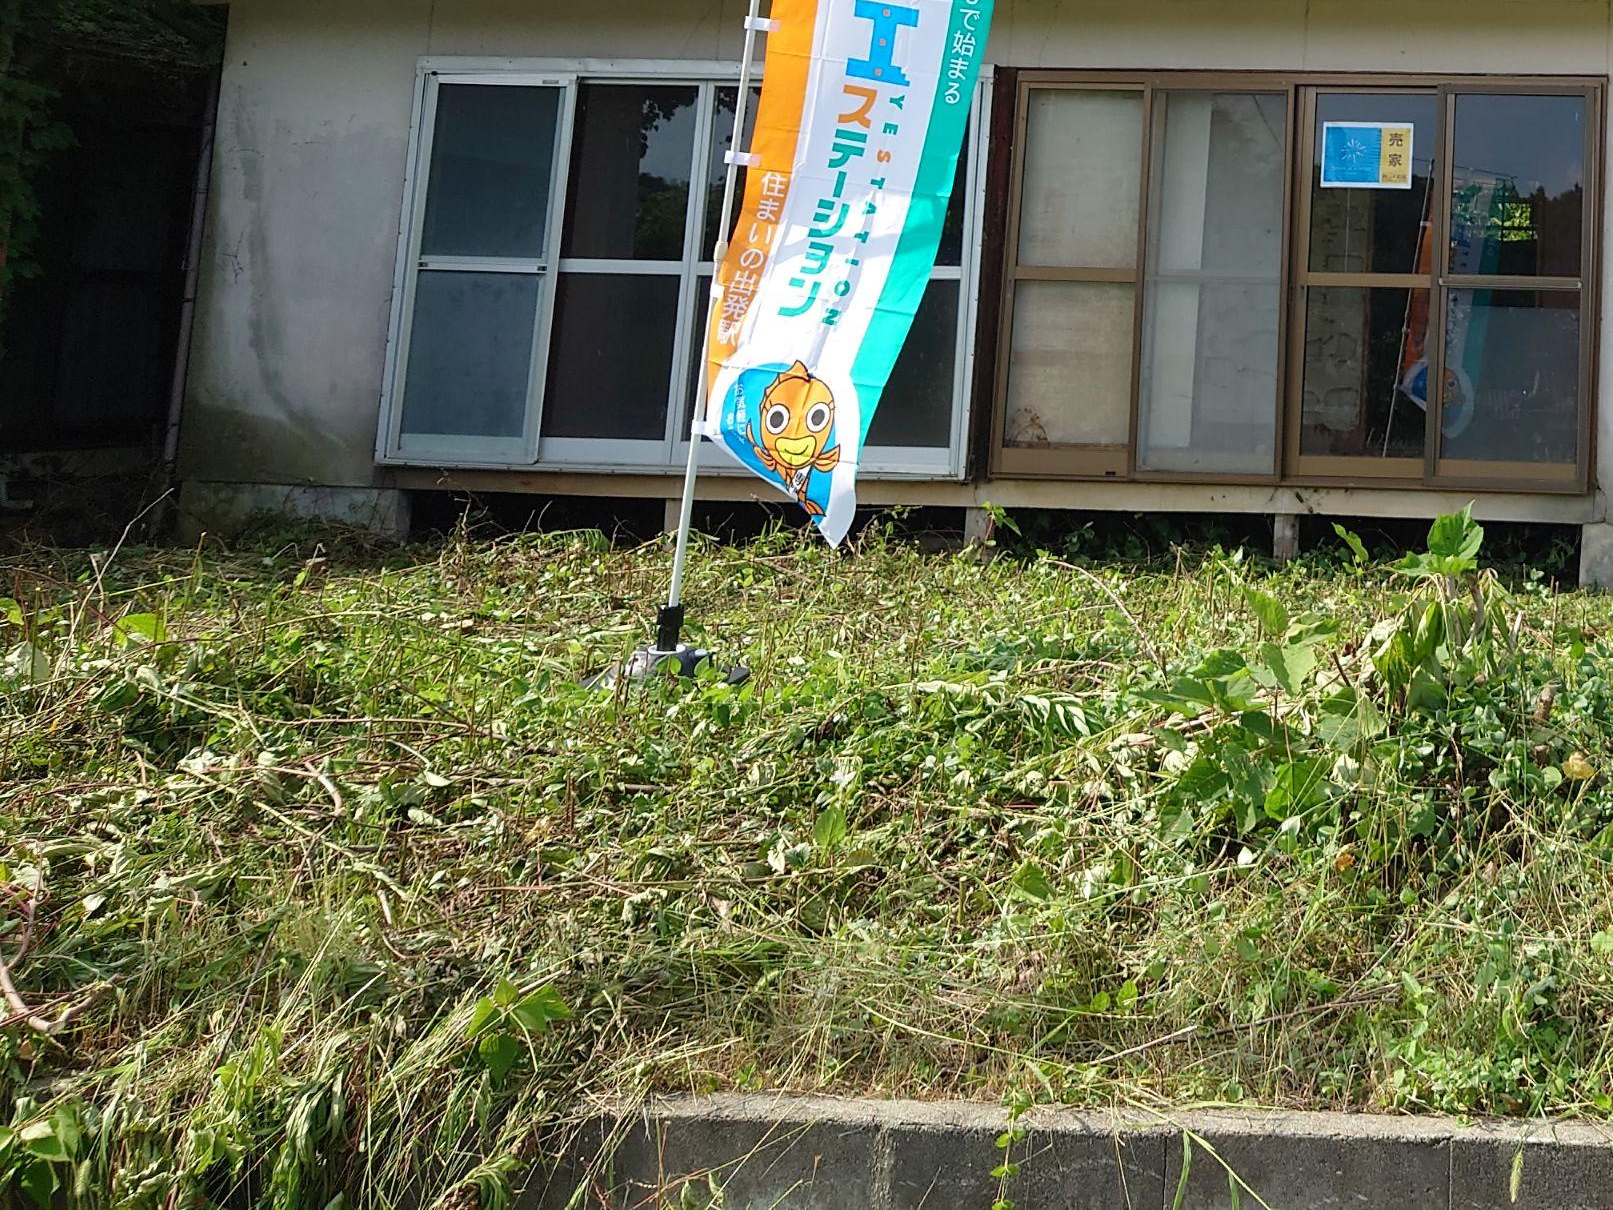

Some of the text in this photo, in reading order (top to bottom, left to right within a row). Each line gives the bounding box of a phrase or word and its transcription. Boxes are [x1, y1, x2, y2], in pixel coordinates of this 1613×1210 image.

[1388, 132, 1404, 167] 売家
[717, 171, 787, 346] 住まいの出発駅
